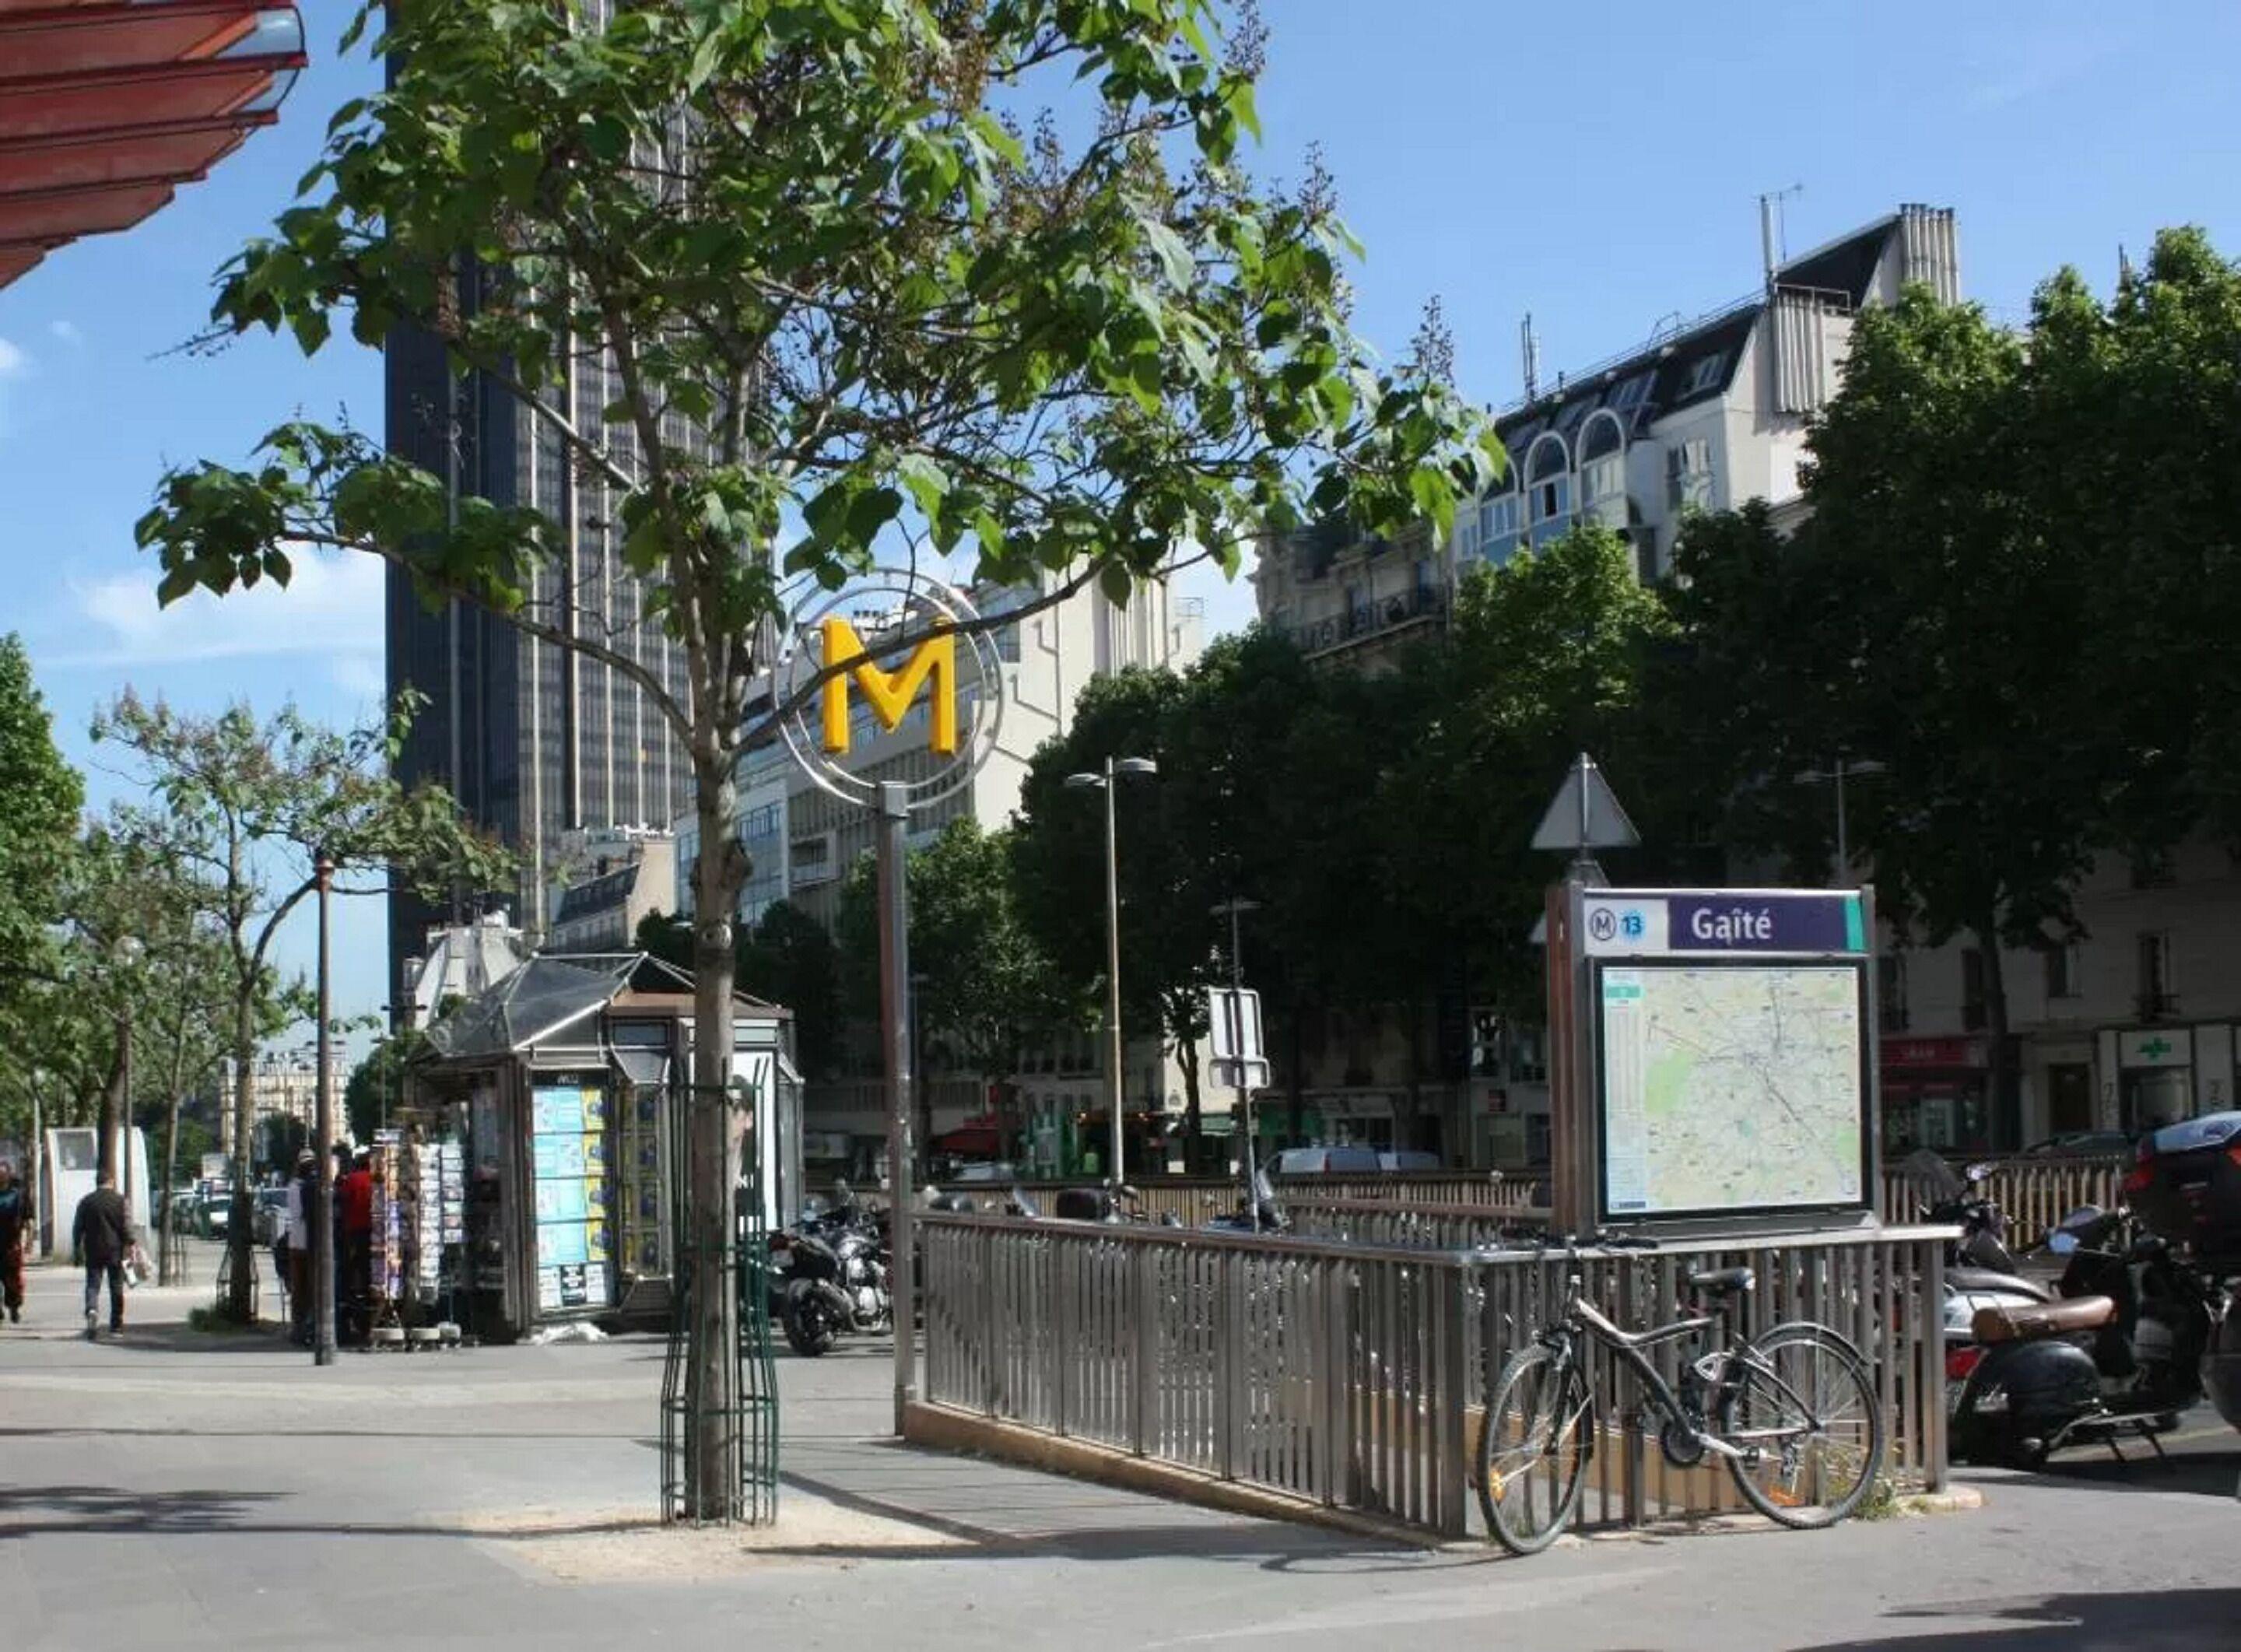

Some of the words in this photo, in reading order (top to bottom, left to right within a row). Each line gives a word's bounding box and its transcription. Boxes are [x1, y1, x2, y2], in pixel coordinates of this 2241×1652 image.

[822, 616, 956, 754] M
[1622, 915, 1642, 935] 13
[1692, 907, 1773, 943] Gaîté
